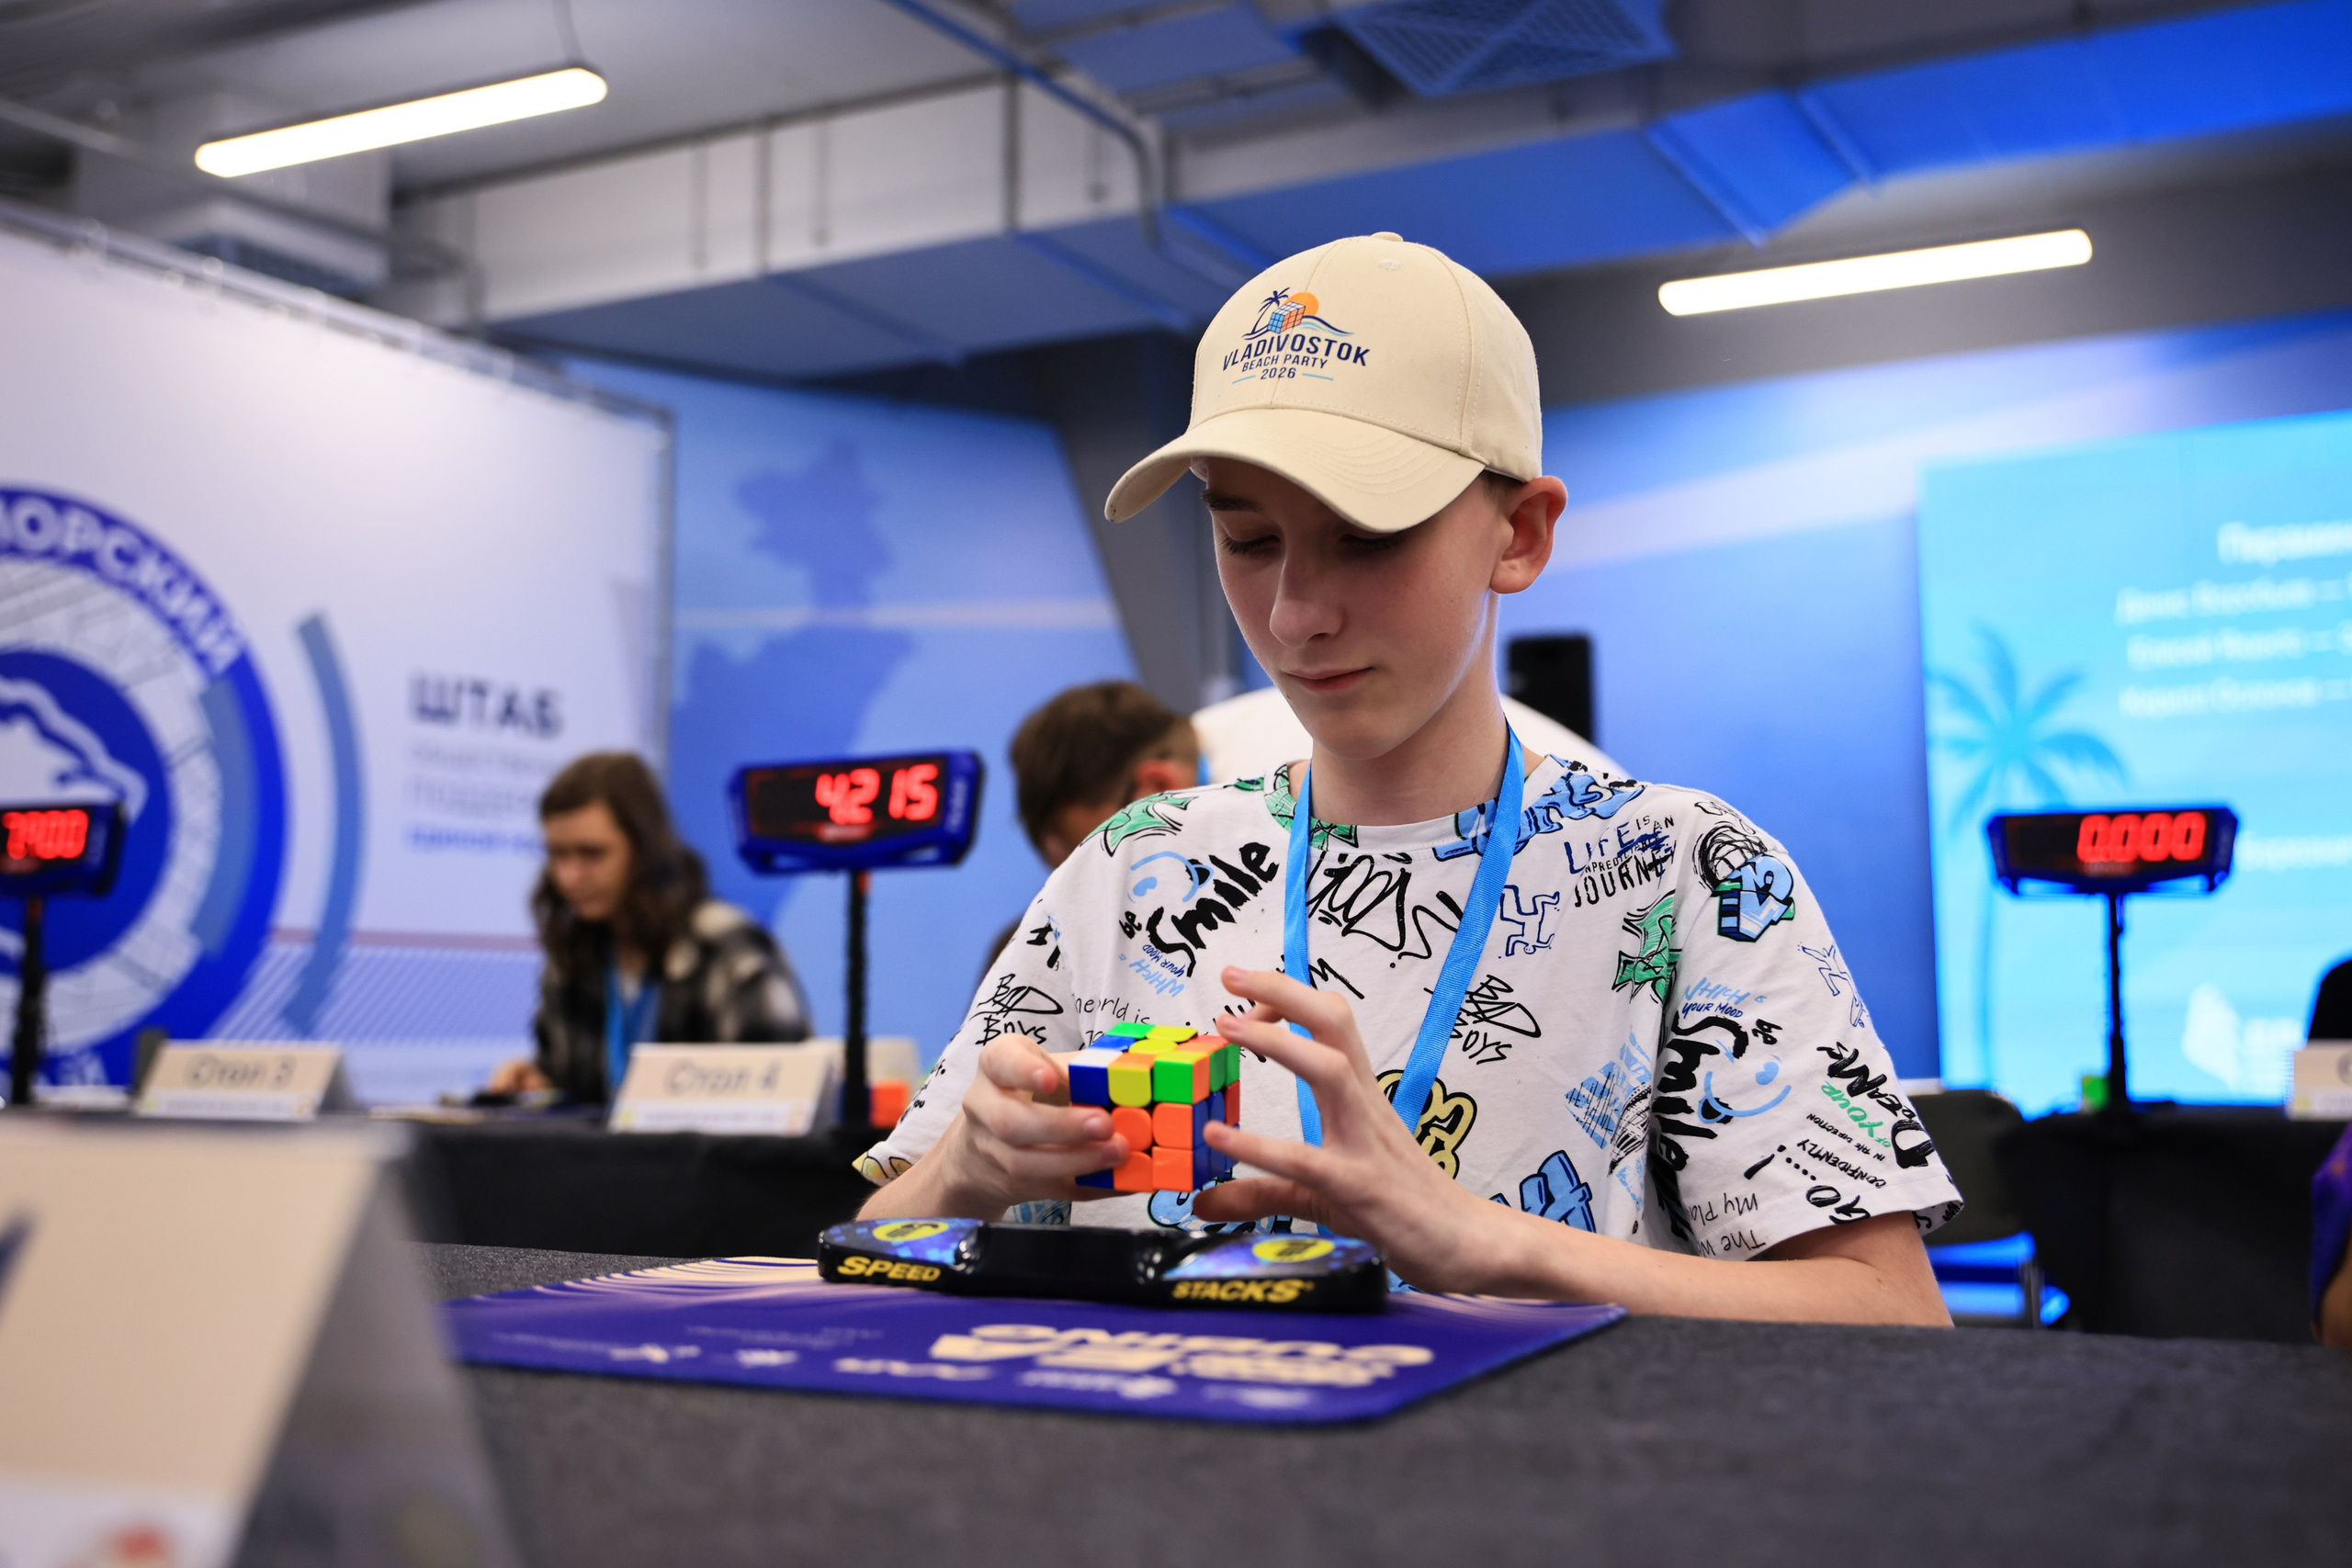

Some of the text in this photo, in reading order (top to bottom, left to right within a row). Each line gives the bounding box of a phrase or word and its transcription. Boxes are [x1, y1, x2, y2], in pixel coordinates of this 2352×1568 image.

[1223, 333, 1370, 372] VLADIVOSTOK
[1242, 354, 1328, 372] BEACH PARTY
[1261, 367, 1296, 380] 2026
[411, 673, 562, 740] ШТАБ
[1142, 944, 1164, 964] MOOD
[1715, 1003, 1744, 1019] MOOD
[1821, 1081, 1883, 1138] YOUR
[1806, 1112, 1854, 1144] DIRECTION
[1796, 1139, 1886, 1189] CONFIDENTLY
[837, 1256, 941, 1281] SPEED
[1171, 1279, 1306, 1303] STACKS
